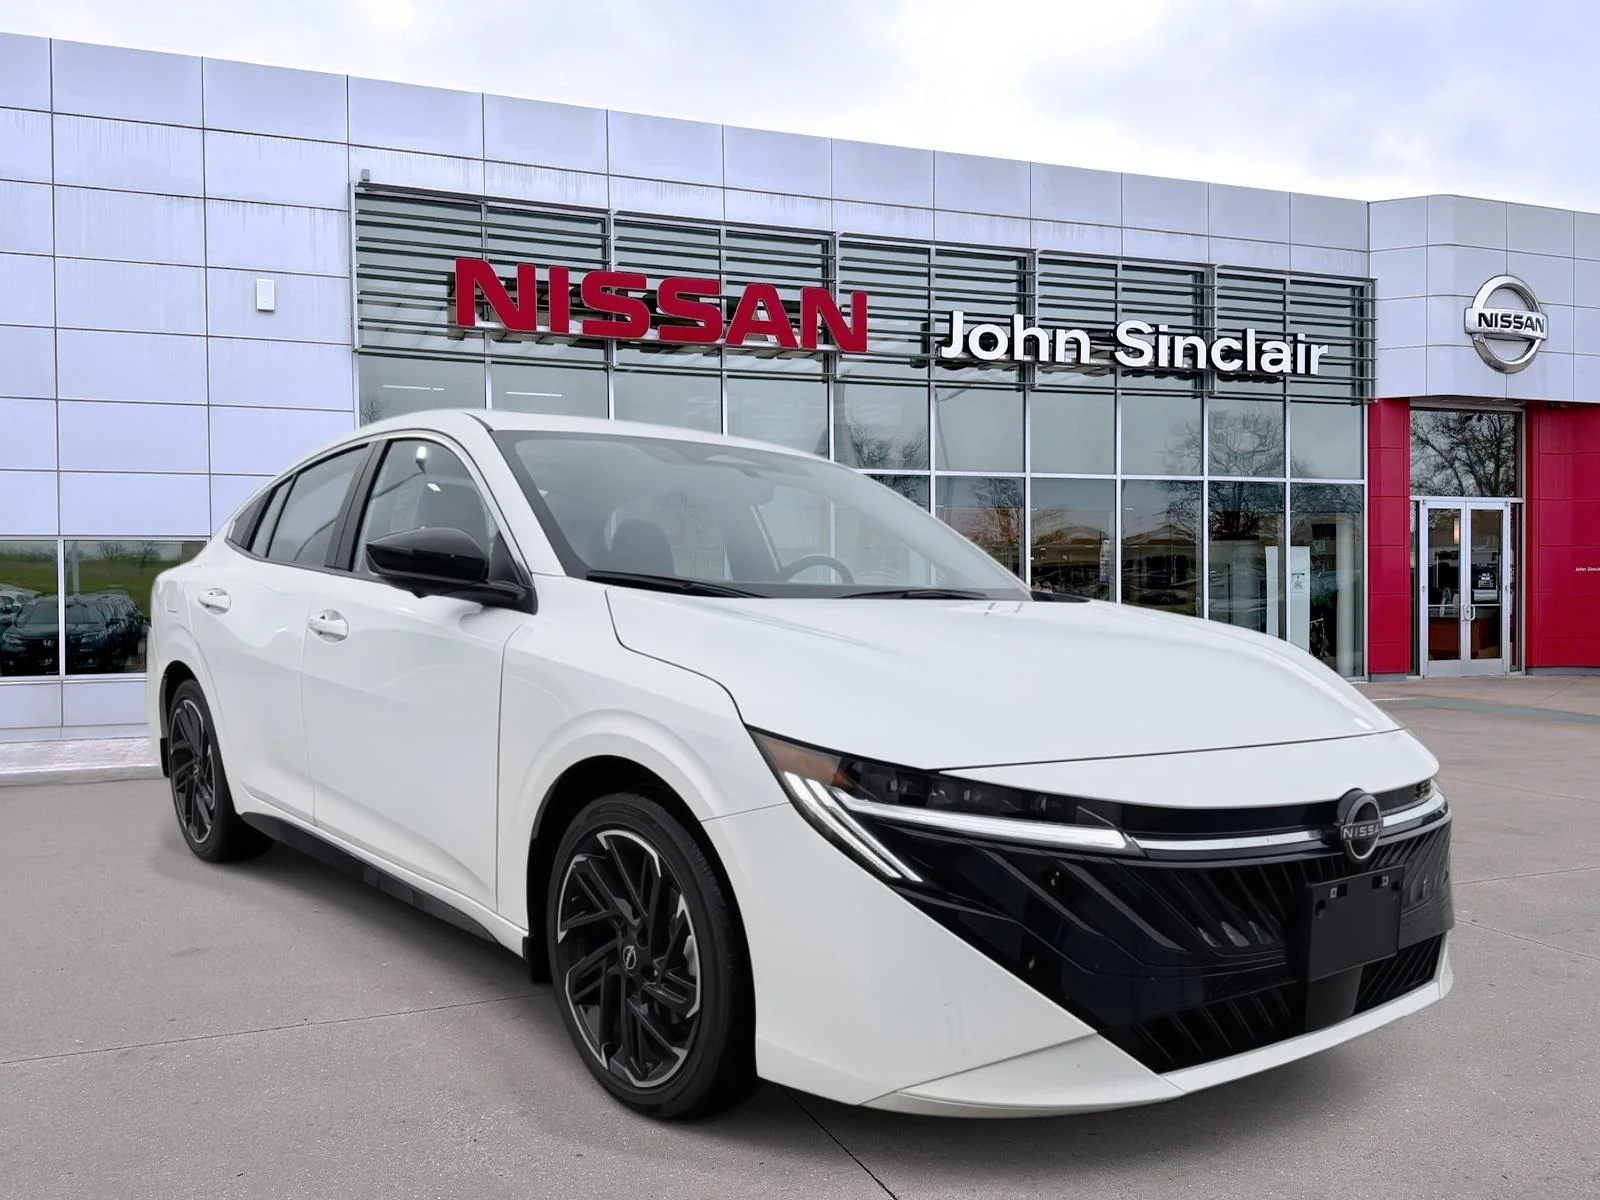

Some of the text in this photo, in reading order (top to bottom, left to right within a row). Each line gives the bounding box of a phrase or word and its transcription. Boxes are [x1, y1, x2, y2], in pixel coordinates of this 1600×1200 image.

[455, 257, 868, 353] NISSAN
[1477, 312, 1545, 333] NISSAN
[941, 310, 1329, 375] John Sinclair
[1343, 824, 1379, 839] NISS
